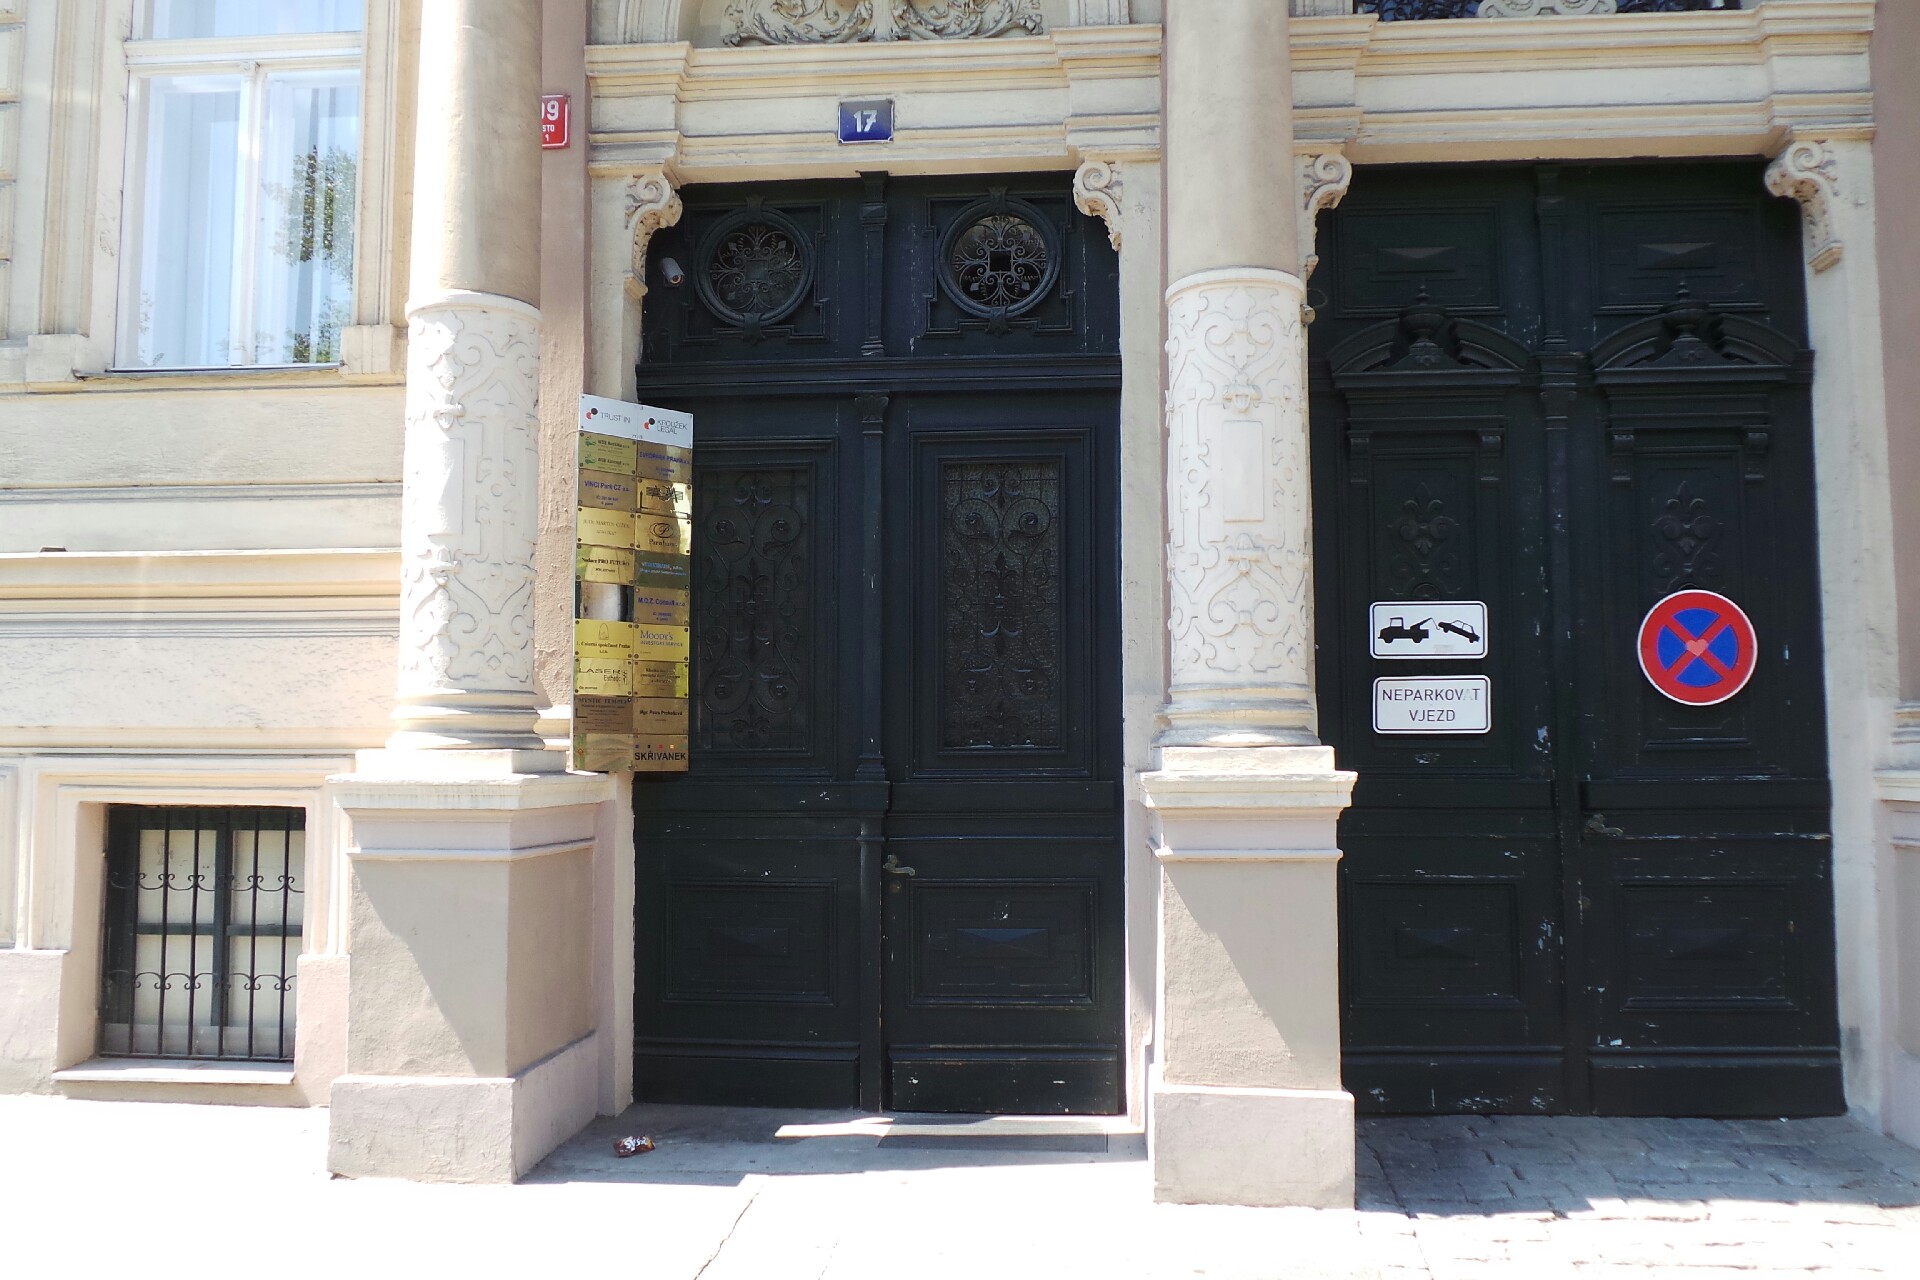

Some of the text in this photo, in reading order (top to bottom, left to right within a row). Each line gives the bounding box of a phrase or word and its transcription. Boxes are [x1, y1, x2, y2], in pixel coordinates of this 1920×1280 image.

[541, 100, 559, 120] 9
[854, 110, 877, 133] 17
[600, 412, 622, 422] TRUST
[657, 419, 688, 430] KROUŽEK
[657, 425, 678, 434] LEGAL
[584, 480, 600, 488] VINCI
[1382, 689, 1480, 701] NEPARKOVAT
[1409, 710, 1456, 722] VJEZD
